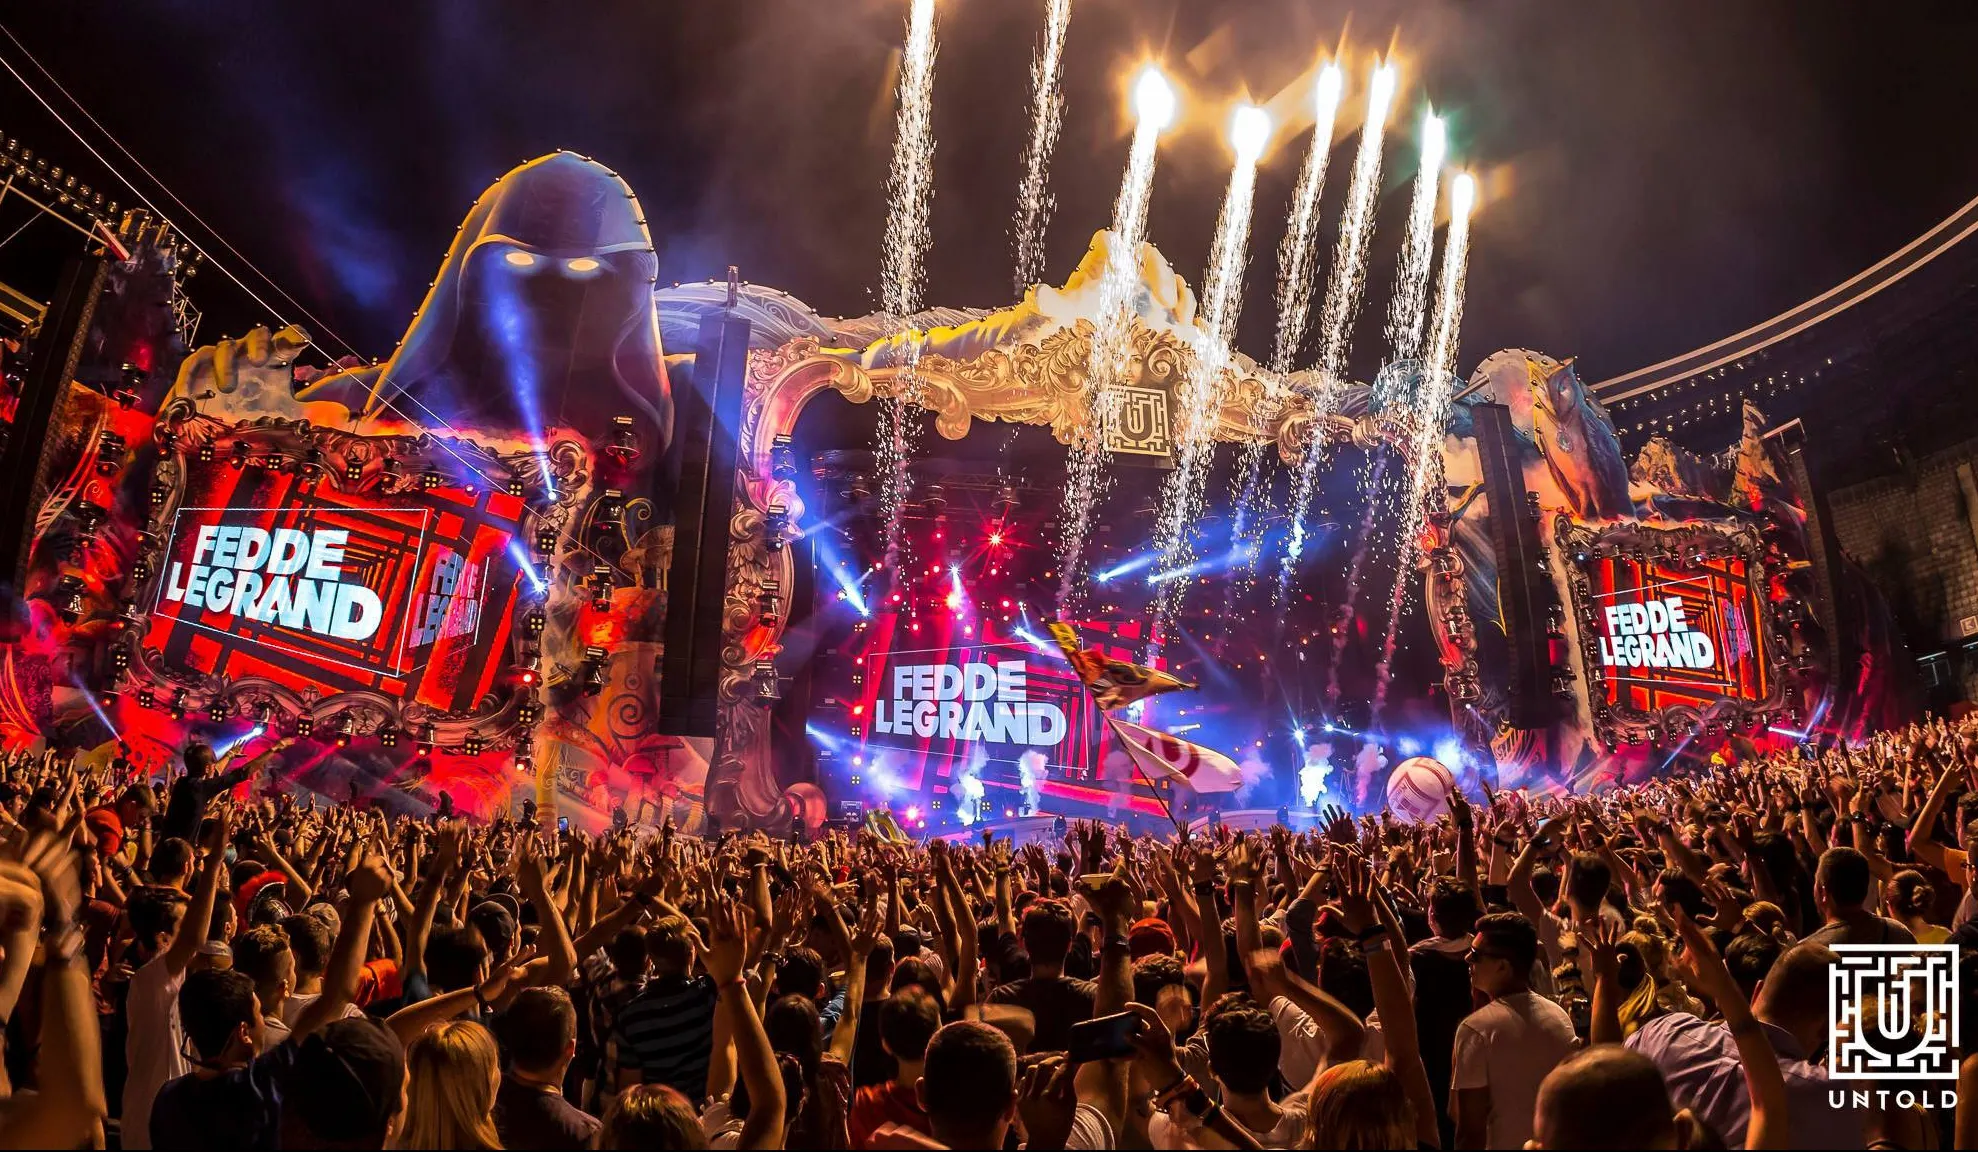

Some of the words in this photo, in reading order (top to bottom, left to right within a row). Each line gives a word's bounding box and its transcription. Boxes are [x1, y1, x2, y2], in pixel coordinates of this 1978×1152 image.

[193, 524, 349, 581] FEDDE
[165, 561, 383, 641] LEGRAND
[1604, 596, 1688, 635] FEDDE
[1599, 631, 1715, 668] LEGRAND
[893, 660, 1027, 702] FEDDE
[875, 700, 1067, 746] LEGRAND
